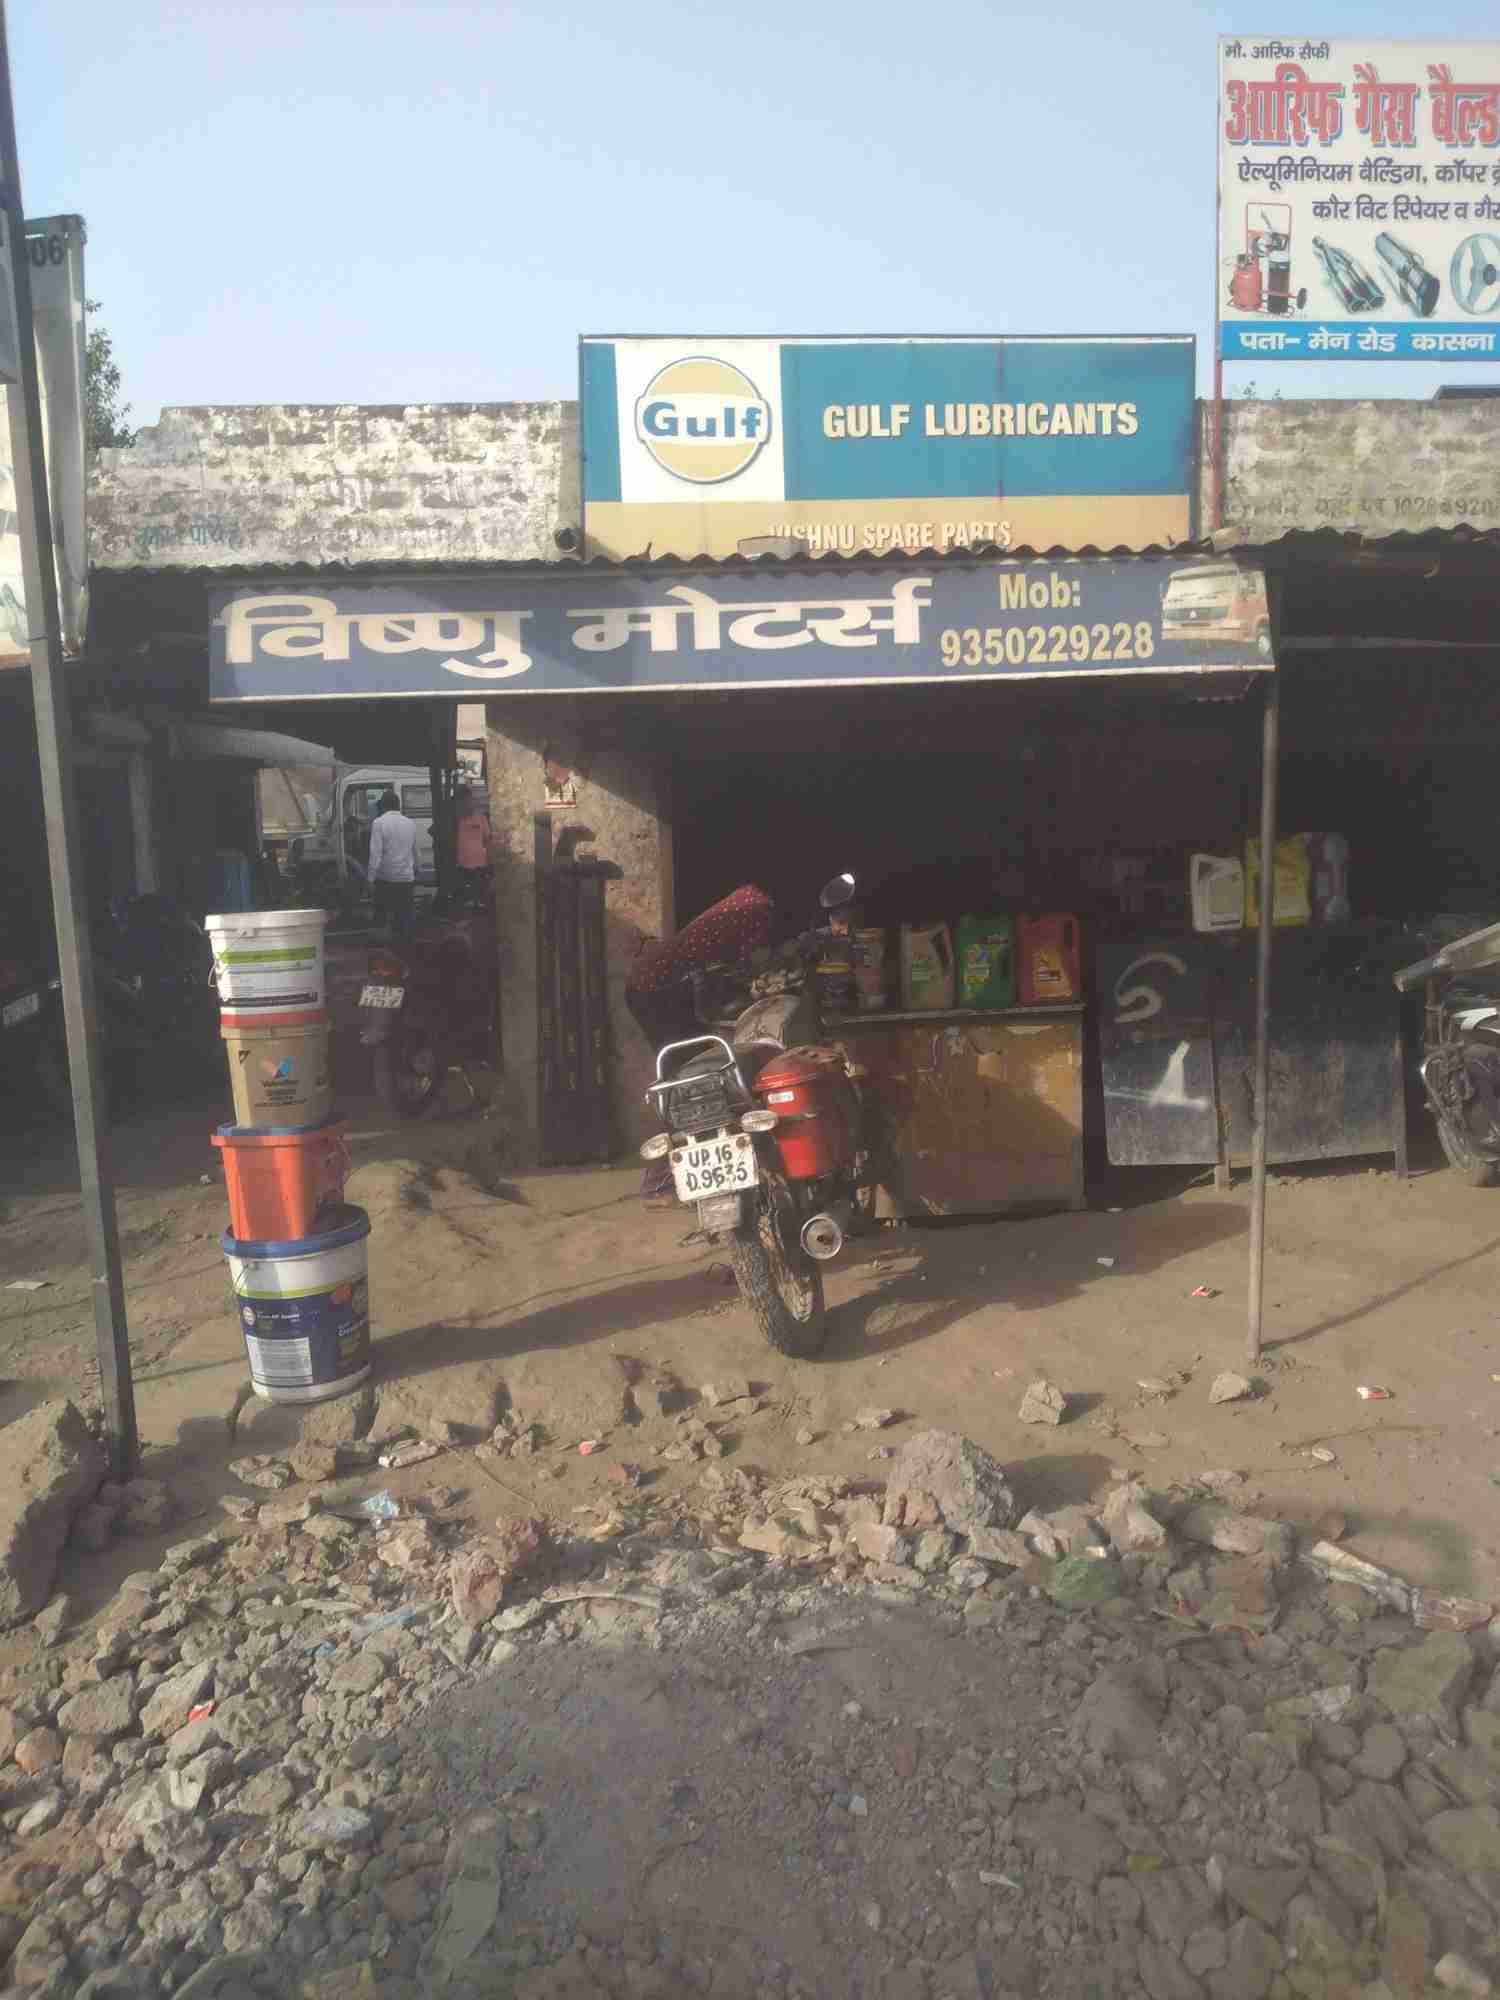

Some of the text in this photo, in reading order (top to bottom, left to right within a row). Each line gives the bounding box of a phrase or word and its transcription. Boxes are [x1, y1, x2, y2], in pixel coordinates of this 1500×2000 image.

[1251, 41, 1295, 59] आरिफ
[1299, 40, 1330, 59] सैफी
[1225, 63, 1344, 146] आरिफ
[1352, 63, 1420, 148] गैस
[1238, 155, 1353, 191] ऐल्यूमिनियम
[1435, 159, 1488, 183] कॉपर
[1393, 194, 1450, 221] रिपेयर
[1454, 201, 1469, 220] व
[1308, 327, 1351, 351] मेन
[1358, 328, 1398, 353] रोड
[1411, 333, 1496, 352] कासना
[643, 401, 762, 438] Gulf
[823, 402, 1138, 437] GULF LUBRICANTS
[863, 522, 935, 549] SPARE
[942, 520, 1011, 548] PARTS
[1000, 573, 1081, 609] Mob:
[211, 578, 933, 679] विष्णु मोटर्स
[941, 621, 1154, 667] 9350229228
